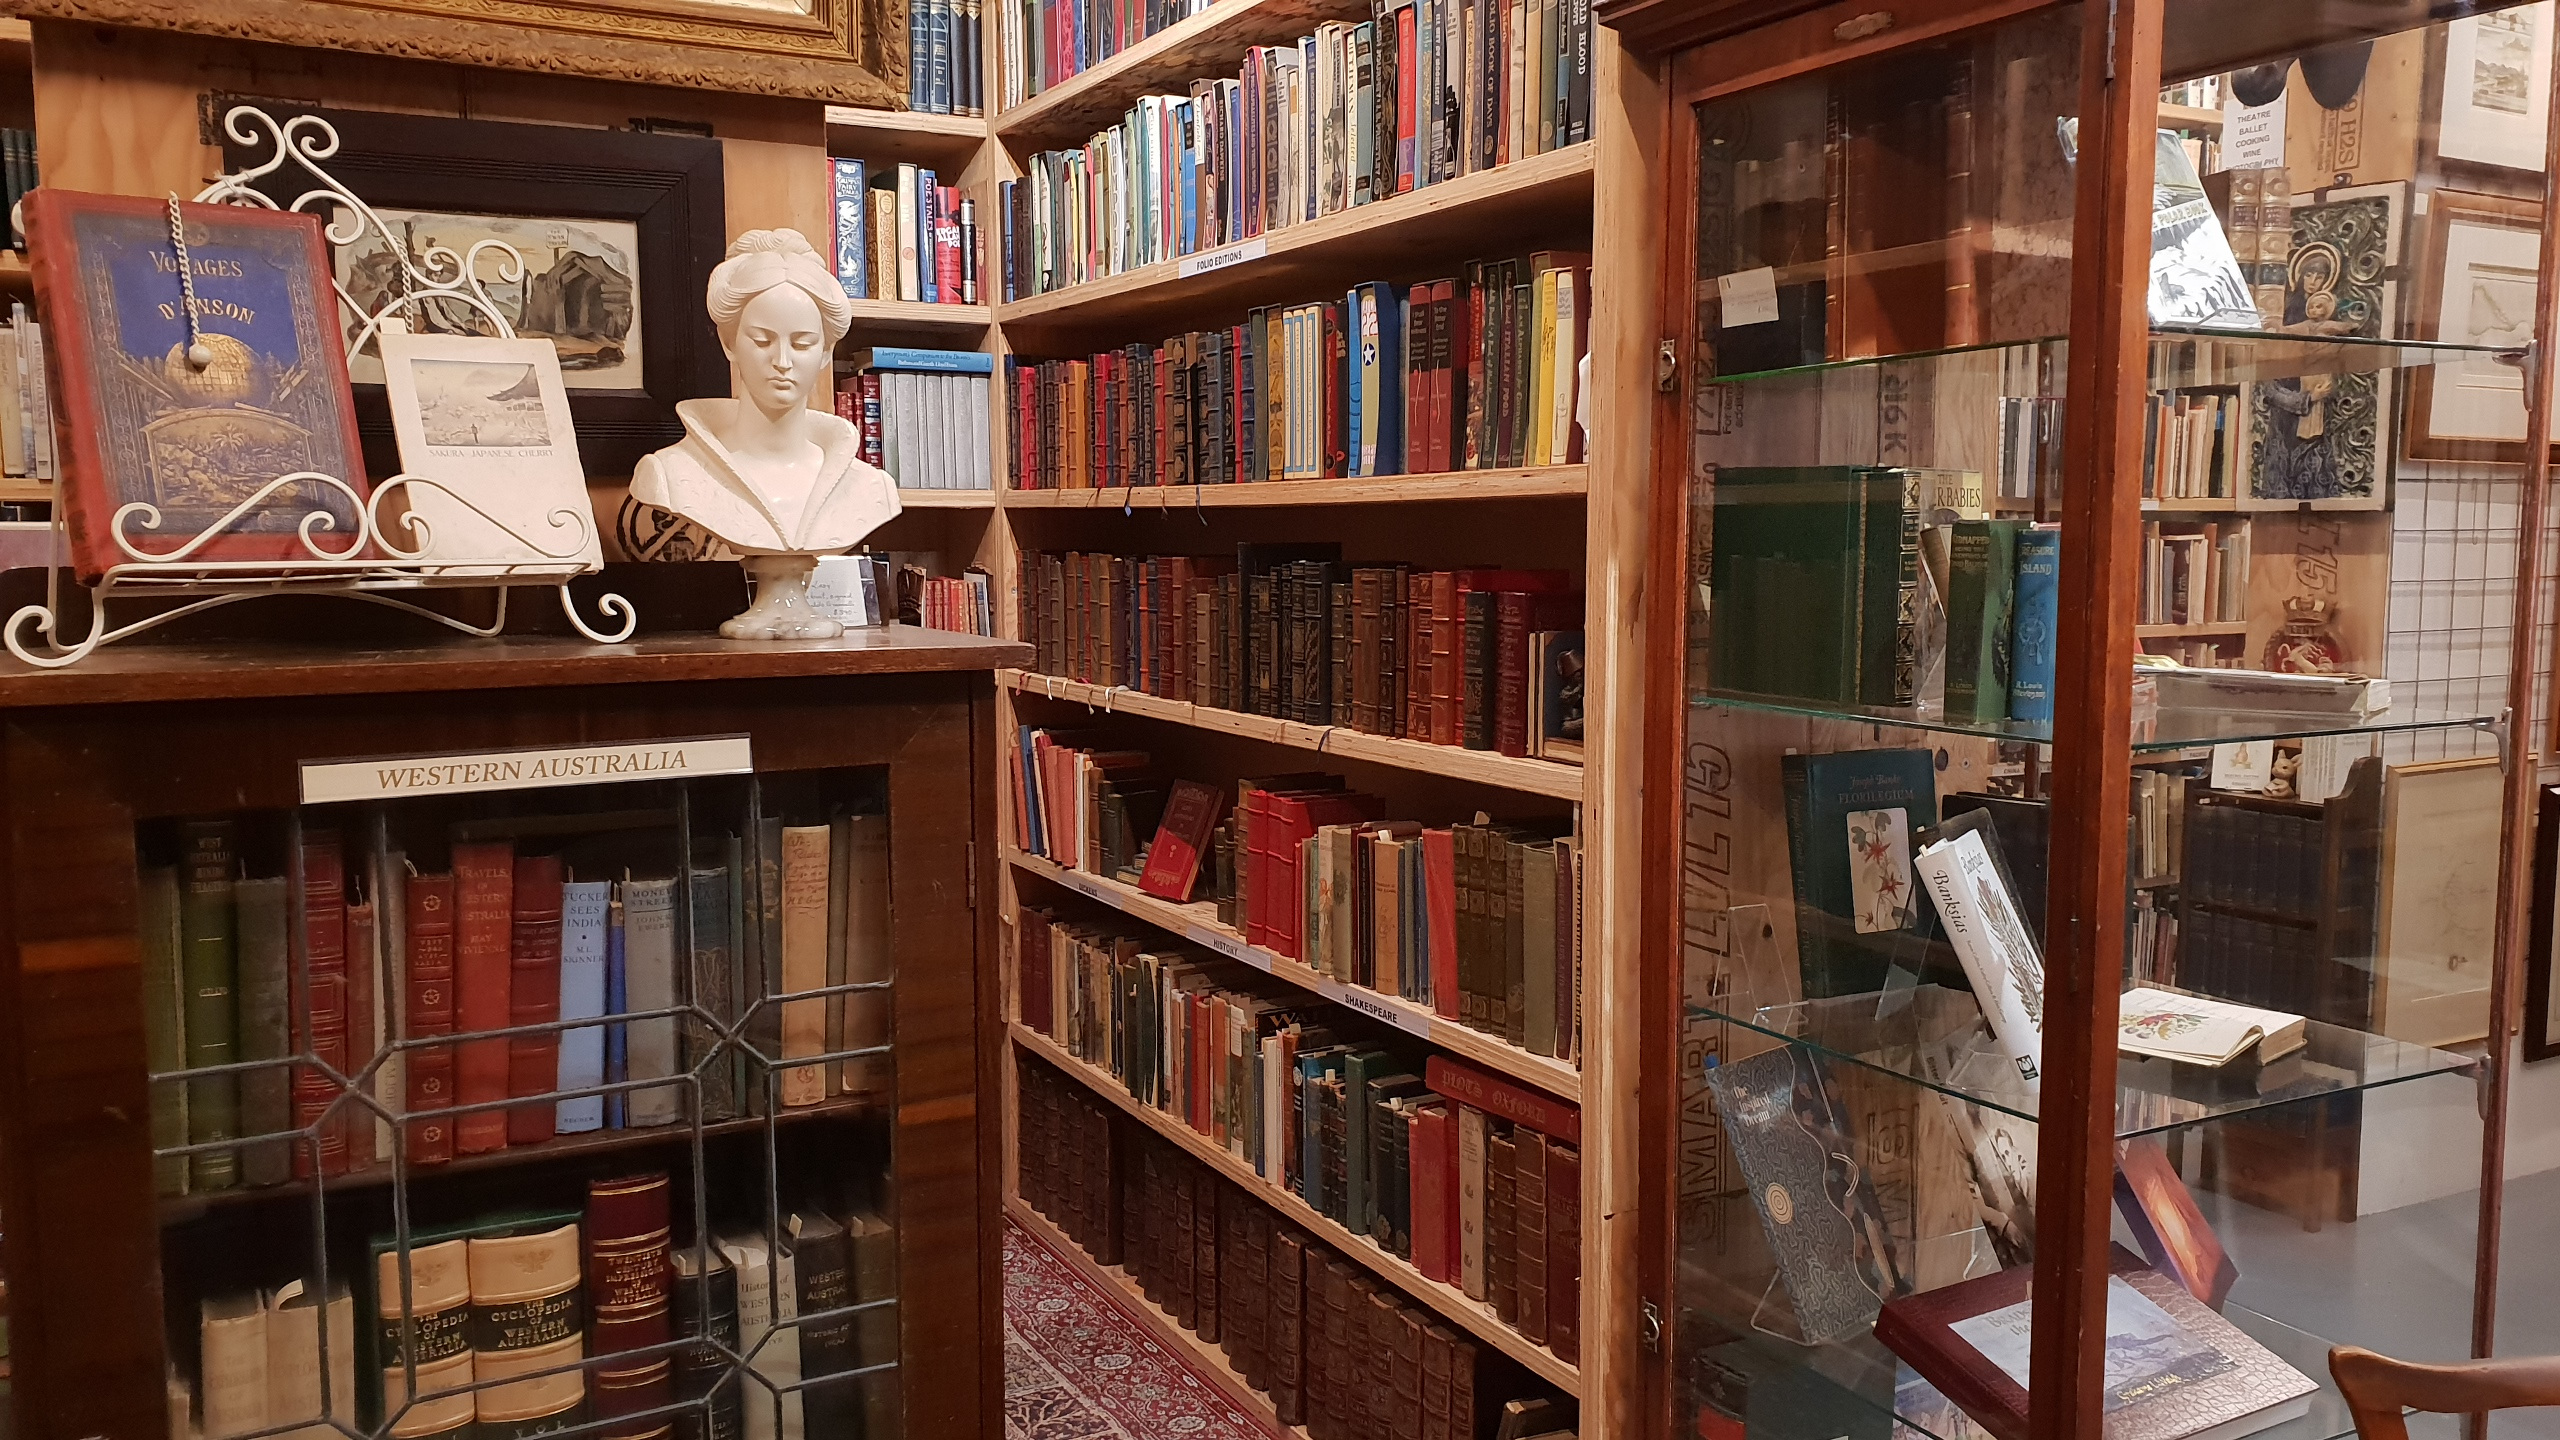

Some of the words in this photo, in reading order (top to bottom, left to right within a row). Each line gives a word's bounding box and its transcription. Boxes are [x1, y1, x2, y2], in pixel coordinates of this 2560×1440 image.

[1578, 31, 1586, 75] BLOOD
[1486, 77, 1493, 93] OF
[1485, 98, 1493, 128] DAYS
[2237, 110, 2271, 124] THEATRE
[2239, 123, 2268, 136] BALLET
[2235, 135, 2270, 148] COOKING
[2338, 119, 2356, 165] H2S
[2242, 148, 2261, 159] WINE
[149, 251, 243, 278] VOAGES
[1197, 258, 1213, 271] FOLIO
[1215, 250, 1242, 266] EDITIONS
[1503, 331, 1511, 382] ITALIAN
[429, 449, 465, 458] SAKURA
[471, 449, 515, 458] JAPANESE
[517, 449, 553, 458] CHERRY
[1937, 474, 1953, 485] THE
[1934, 487, 1981, 508] R-BABIES
[2019, 562, 2052, 576] ISLAND
[376, 759, 522, 790] WESTERN
[528, 749, 688, 780] AUSTRALIA
[1838, 789, 1914, 804] FLORILEGIUM
[459, 866, 508, 879] TRAVELS
[564, 891, 609, 902] TUCKER
[632, 889, 673, 899] MONEY
[1933, 869, 1968, 934] Banksias
[462, 910, 511, 921] STRALIA
[570, 906, 600, 915] SEES
[567, 918, 602, 928] INDIA
[1213, 938, 1239, 957] HISTORY
[563, 955, 604, 964] SKINNER
[1345, 993, 1398, 1024] SHAKESPEARE
[1733, 1086, 1748, 1099] The
[1739, 1091, 1771, 1113] Inspired
[1742, 1110, 1771, 1127] Dream
[741, 1282, 770, 1293] Histor
[779, 1274, 789, 1284] of
[739, 1293, 791, 1310] WESTRN
[491, 1298, 573, 1323] CYCLOPEDIA
[385, 1313, 470, 1338] CYLOPEDIA
[503, 1317, 566, 1339] WESTERN
[529, 1316, 543, 1325] OF
[423, 1331, 437, 1340] OF
[497, 1326, 570, 1349] AUSTRALIA
[391, 1339, 467, 1365] ASTRALIA
